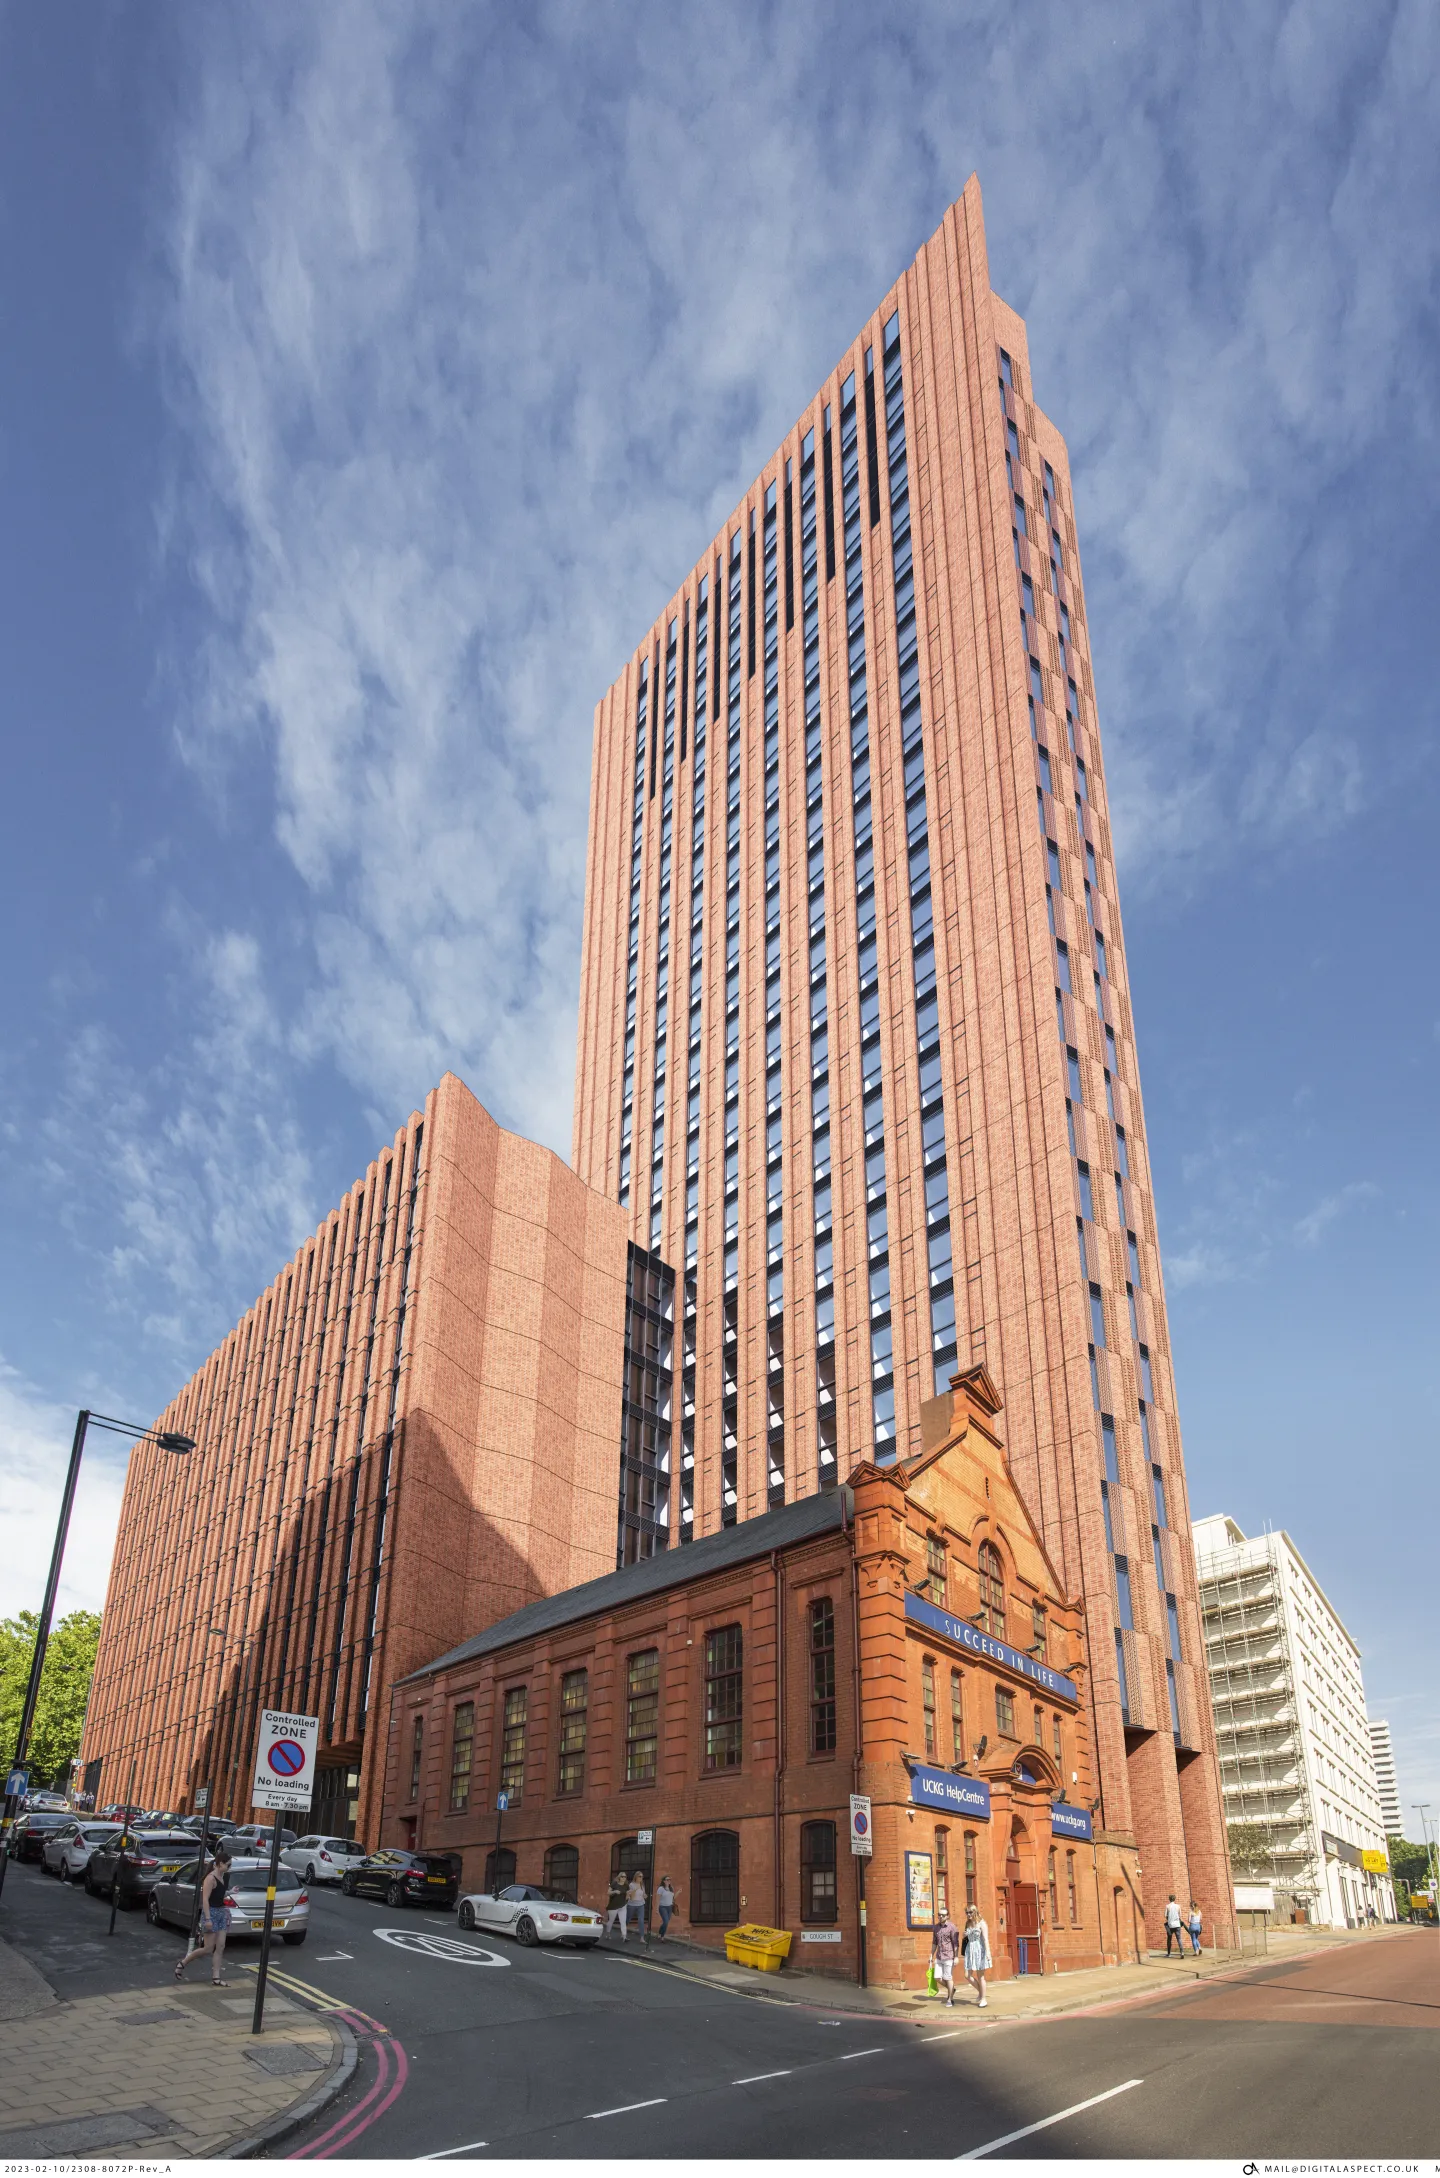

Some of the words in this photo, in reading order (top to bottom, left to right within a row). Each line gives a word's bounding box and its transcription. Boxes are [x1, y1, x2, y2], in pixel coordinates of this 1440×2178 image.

[944, 1619, 1004, 1661] SUCCEED
[1011, 1654, 1024, 1673] IN
[1031, 1664, 1054, 1688] LIFE
[265, 1712, 316, 1728] Controlled
[271, 1724, 307, 1739] ZONE
[257, 1776, 272, 1786] No
[274, 1778, 310, 1791] loading
[267, 1793, 285, 1802] Every
[286, 1795, 298, 1803] day
[922, 1778, 944, 1796] UCKG
[946, 1785, 985, 1806] HelpCentre
[853, 1802, 868, 1811] ZONE
[1051, 1812, 1086, 1831] www.uckg.org
[394, 1935, 482, 1956] 20
